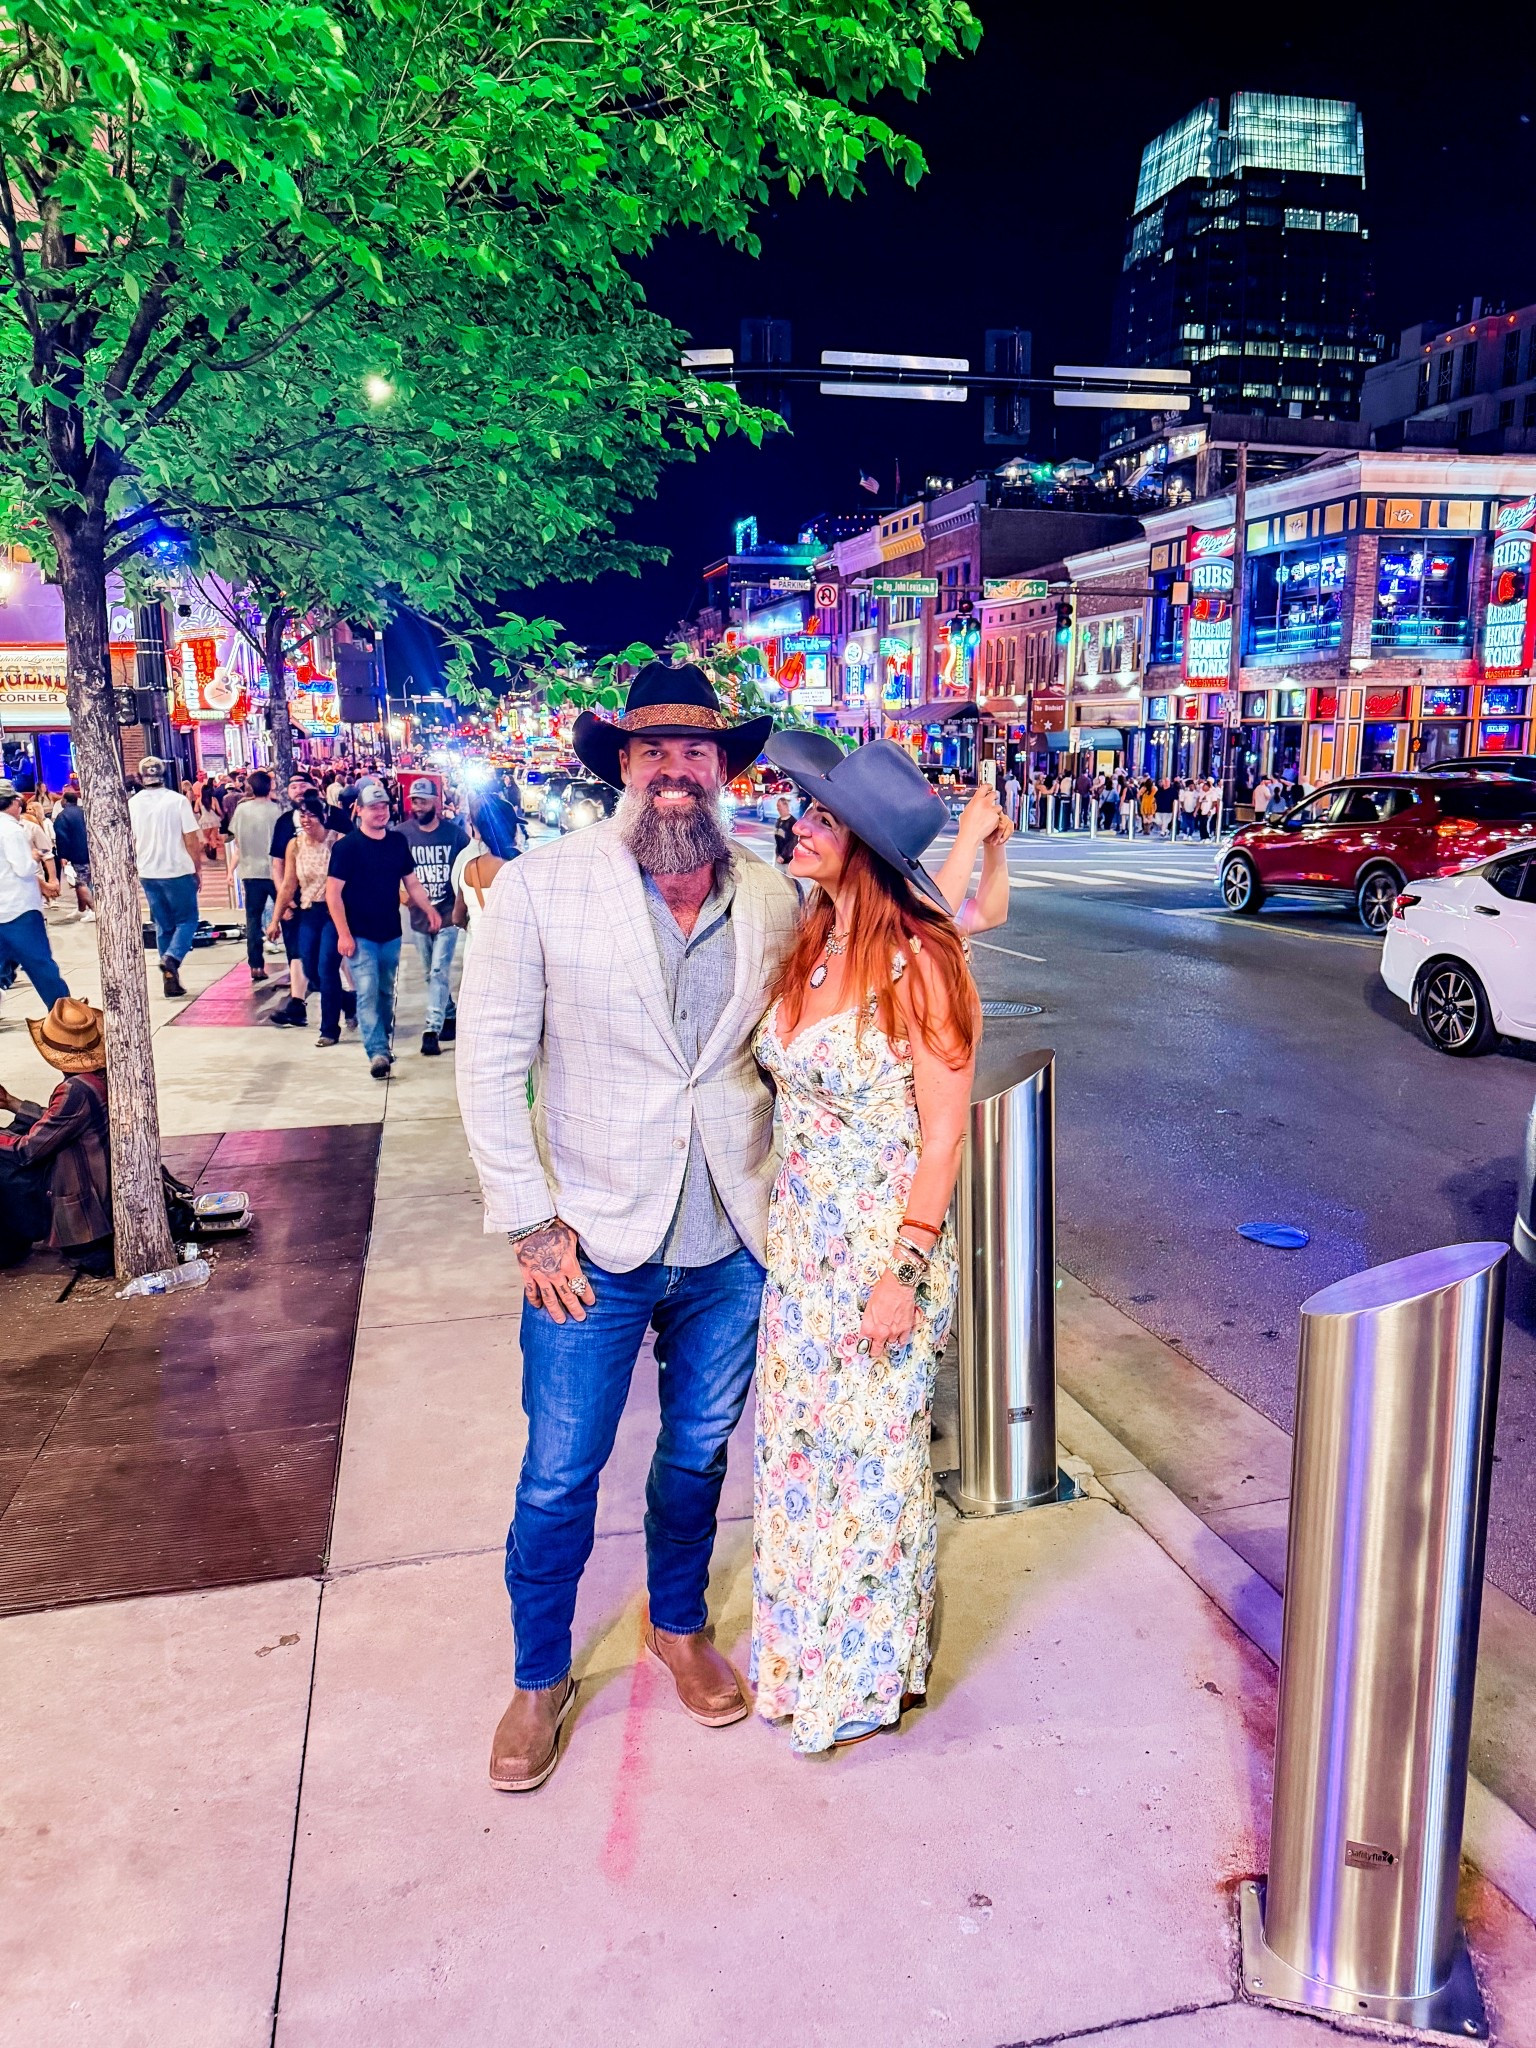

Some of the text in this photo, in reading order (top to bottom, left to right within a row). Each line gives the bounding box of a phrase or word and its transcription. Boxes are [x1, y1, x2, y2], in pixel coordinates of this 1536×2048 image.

[1193, 528, 1236, 556] Rippy's
[1493, 541, 1531, 567] RIBS
[778, 581, 809, 590] PARKING
[1193, 565, 1232, 587] RIBS
[894, 581, 906, 592] John
[907, 581, 922, 592] Lewis
[1485, 624, 1525, 648] HONKY
[1189, 639, 1231, 659] HONKY
[1484, 646, 1523, 668] TONK
[0, 665, 68, 690] GEND
[181, 642, 201, 709] LEGENDS
[1188, 658, 1229, 678] TONK
[1485, 669, 1521, 679] NASHVILLE
[1187, 679, 1226, 688] NASHVILLE
[0, 694, 58, 702] CORNER
[188, 710, 226, 720] CORNER
[414, 864, 451, 883] OWER
[422, 883, 447, 898] SPEC
